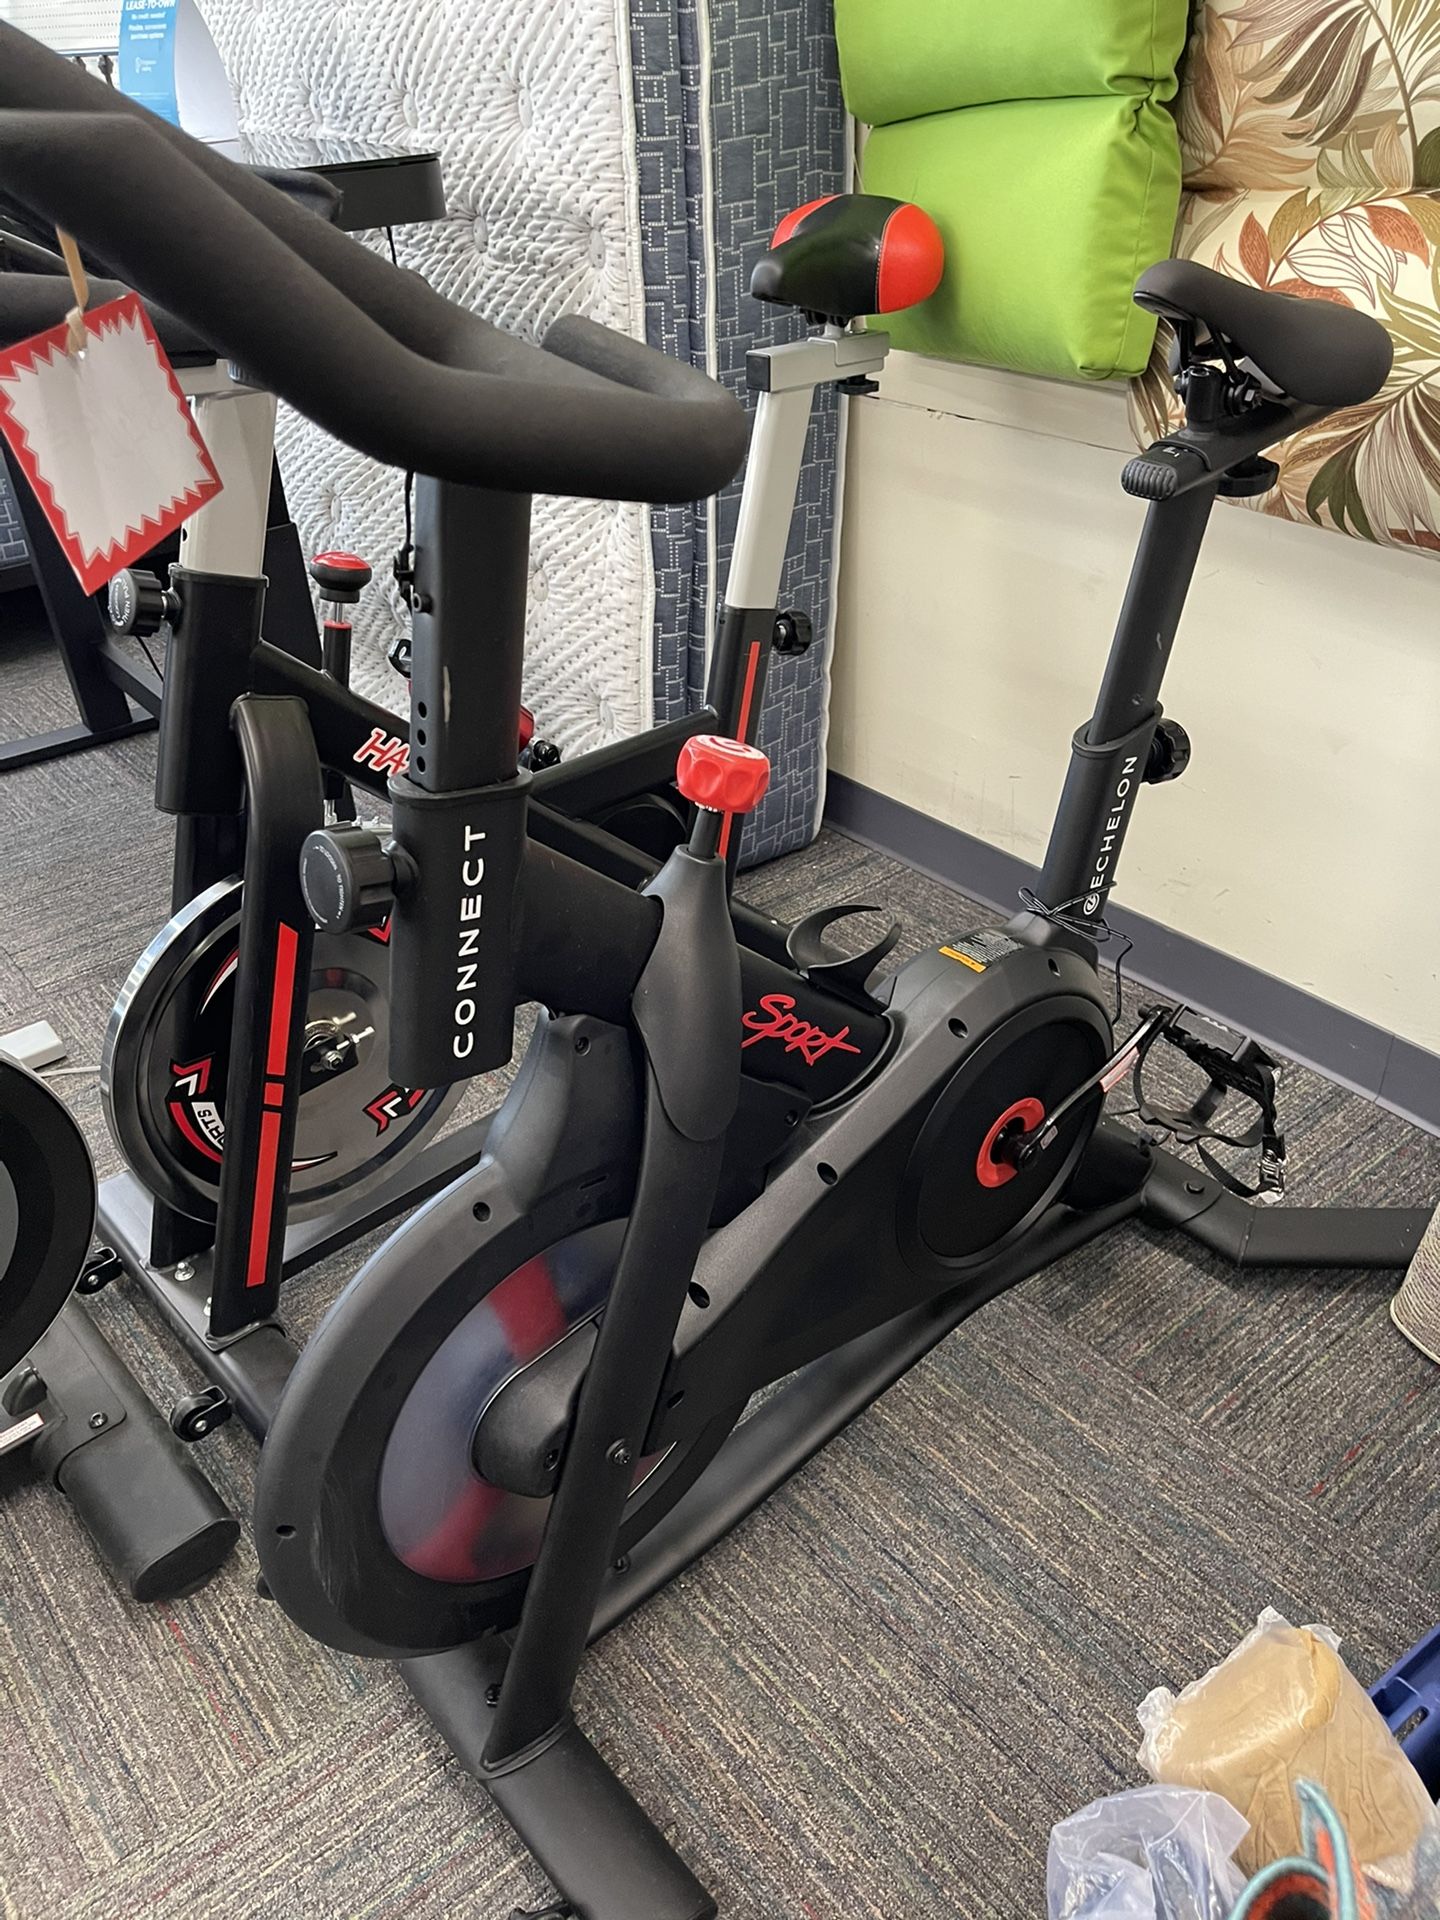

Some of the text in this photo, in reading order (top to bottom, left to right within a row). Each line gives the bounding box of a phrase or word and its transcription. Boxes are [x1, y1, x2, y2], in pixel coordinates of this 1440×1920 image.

[125, 0, 176, 10] LEASE-TO-OWN
[353, 727, 410, 778] HA
[1090, 756, 1138, 889] ECHELON
[453, 825, 486, 1059] CONNECT
